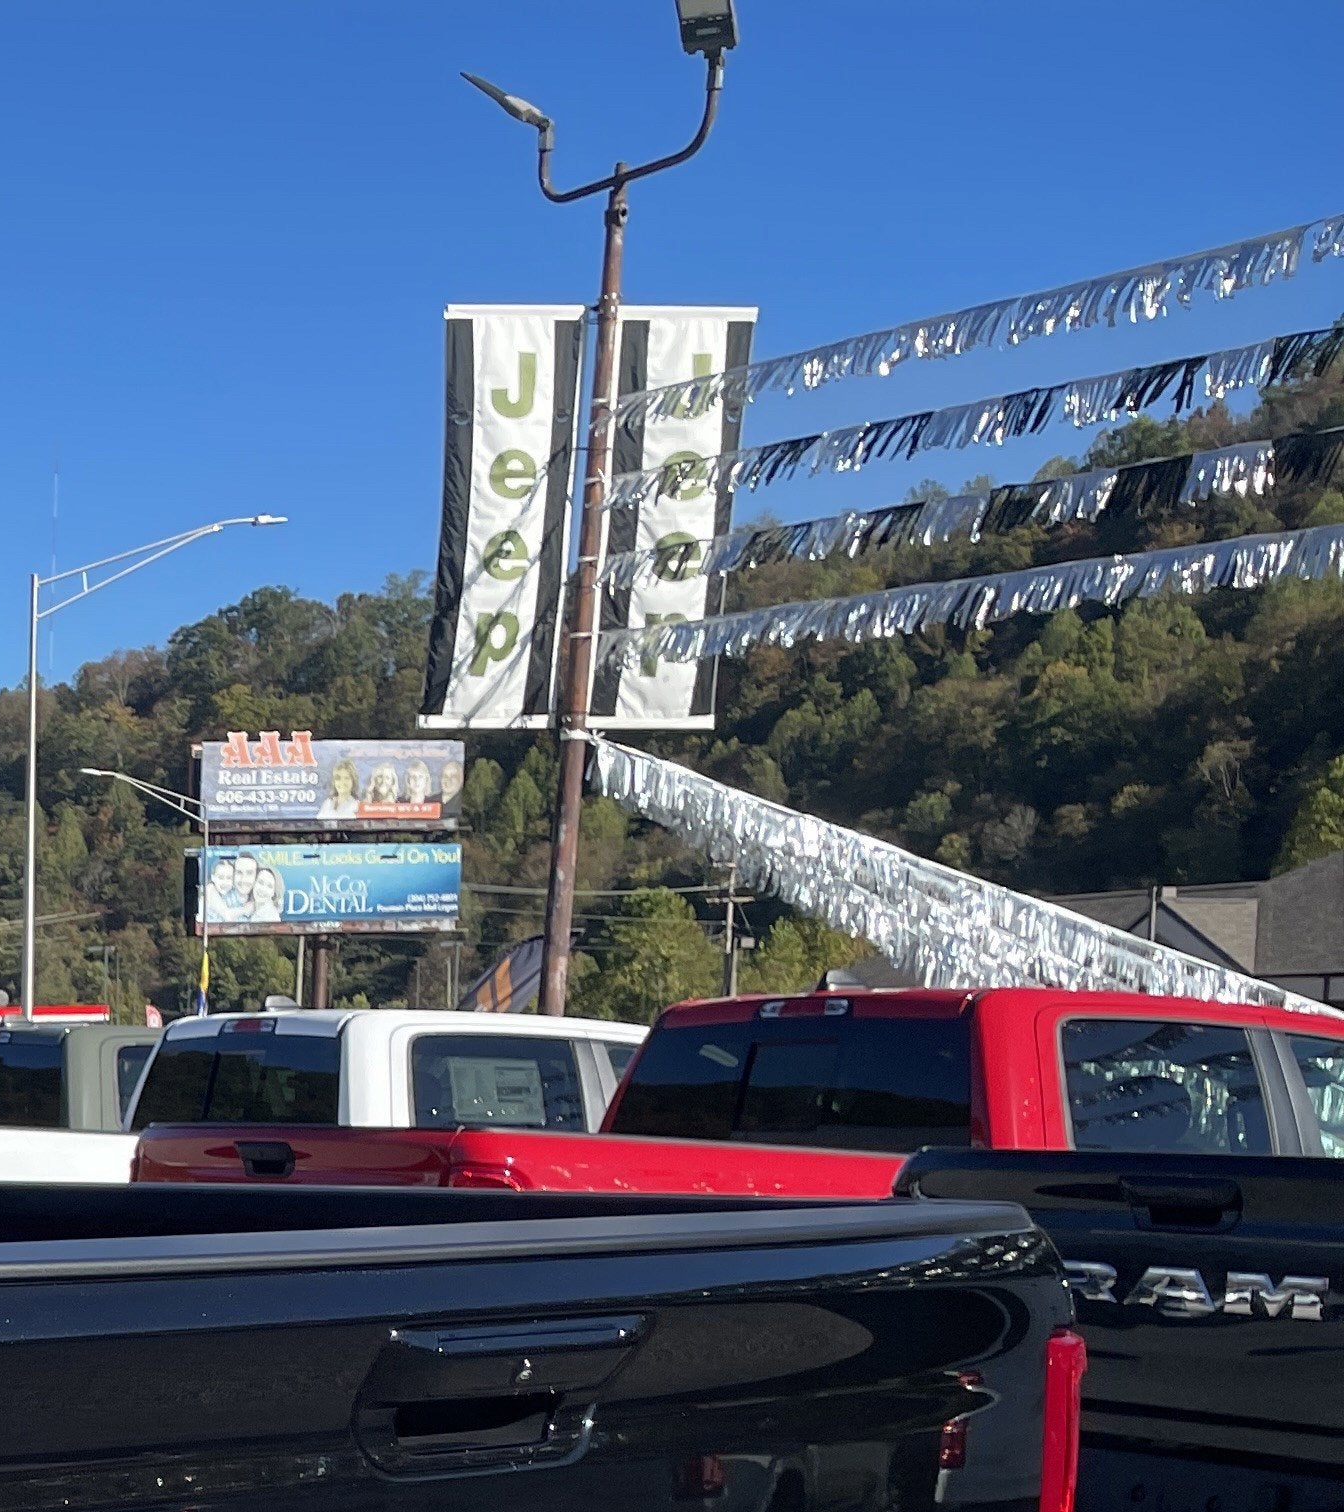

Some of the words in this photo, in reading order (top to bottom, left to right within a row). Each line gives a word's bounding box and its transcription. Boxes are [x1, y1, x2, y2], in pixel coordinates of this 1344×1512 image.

[468, 351, 538, 677] Jeep
[220, 731, 318, 768] AAA
[217, 769, 257, 785] Real
[259, 769, 319, 785] Estate
[215, 789, 316, 804] 606-433-9700
[323, 850, 362, 865] Looks
[407, 848, 429, 864] On
[431, 848, 461, 864] You!
[286, 889, 373, 915] DENTAL
[1062, 1258, 1330, 1321] RAM
